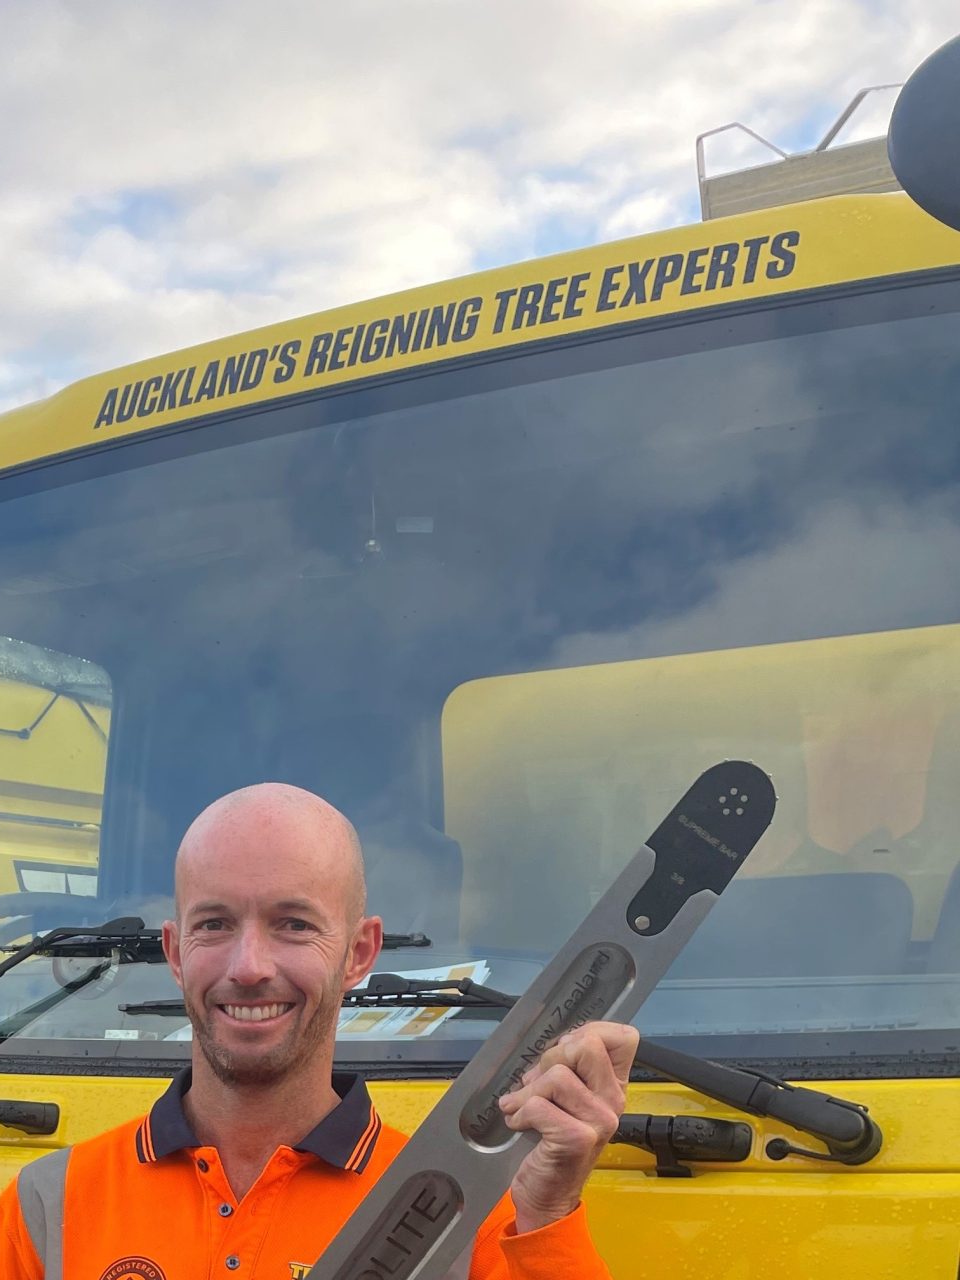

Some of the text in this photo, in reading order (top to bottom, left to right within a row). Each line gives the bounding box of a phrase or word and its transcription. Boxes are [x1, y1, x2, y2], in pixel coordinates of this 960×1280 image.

[94, 231, 800, 429] AUCKLAND'S REIGNING TREE EXPERTS
[719, 844, 739, 860] BAR
[520, 1024, 556, 1064] New
[552, 950, 611, 1023] Zealand
[106, 1262, 156, 1280] REGISTERED
